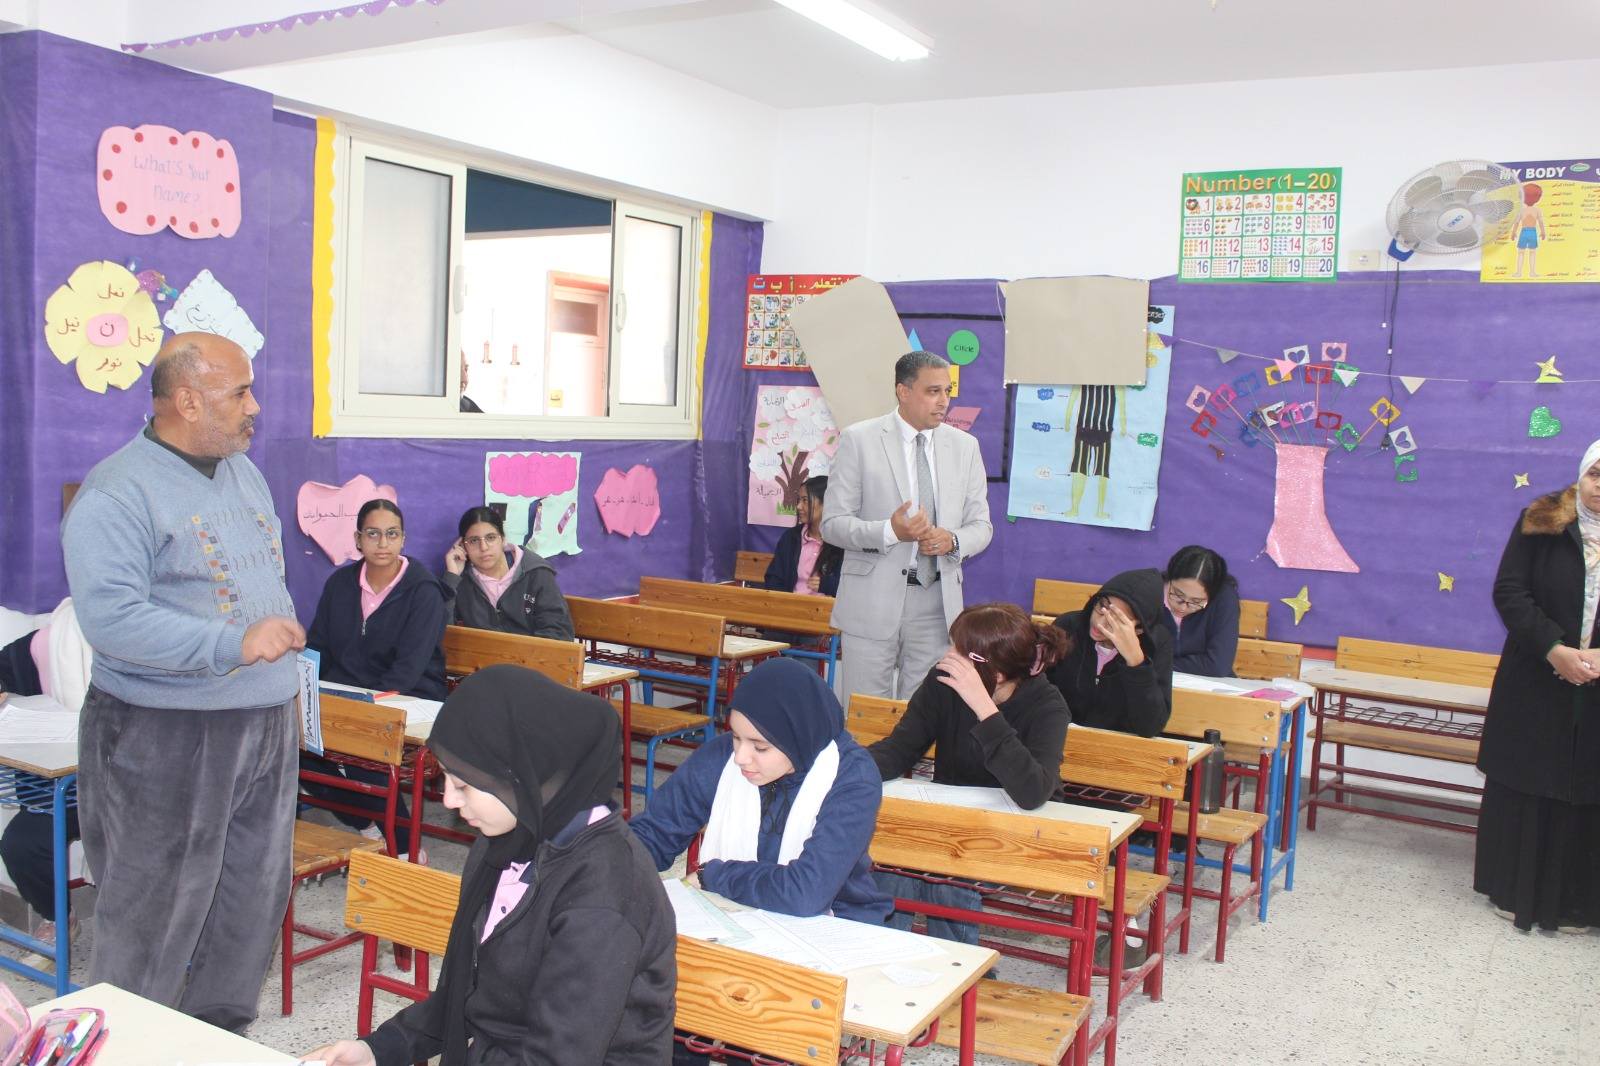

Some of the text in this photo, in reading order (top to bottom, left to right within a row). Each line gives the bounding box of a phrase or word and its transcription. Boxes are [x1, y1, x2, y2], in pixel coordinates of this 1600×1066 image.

[1525, 167, 1566, 179] BODY
[1205, 194, 1335, 211] 1 2 3 4 5
[1204, 216, 1334, 232] 6 7 8 9 10
[1199, 237, 1333, 253] 11 12 13 14 15
[1198, 259, 1332, 273] 16 17 18 19 20
[753, 277, 766, 289] ت
[770, 280, 783, 293] ب
[99, 322, 115, 338] ن
